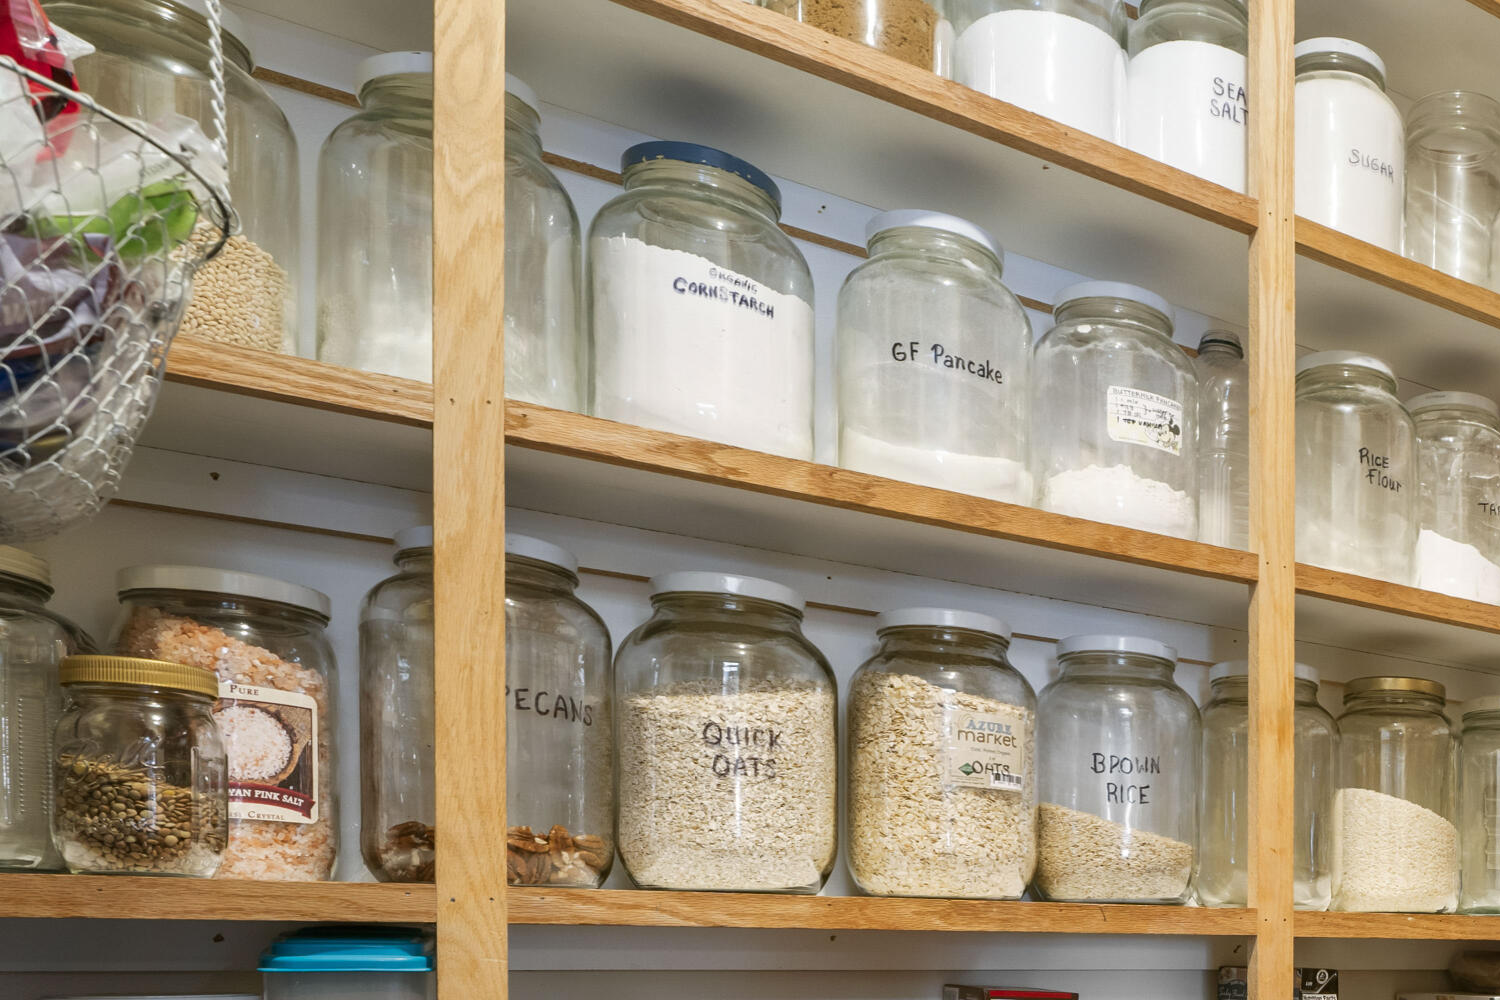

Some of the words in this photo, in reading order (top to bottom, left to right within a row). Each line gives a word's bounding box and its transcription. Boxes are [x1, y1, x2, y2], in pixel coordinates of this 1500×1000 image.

[1213, 77, 1248, 102] SEA
[1348, 149, 1395, 183] SUGAR
[673, 277, 774, 319] CORNSTARCH
[892, 342, 920, 363] GF
[931, 343, 1004, 385] Pancake
[1358, 447, 1389, 469] RICE
[702, 722, 783, 751] QUICK
[958, 730, 1017, 748] market
[966, 720, 1012, 735] AZURE
[711, 753, 777, 780] OATS
[255, 790, 280, 804] PINK
[281, 792, 305, 807] SALT
[1106, 782, 1151, 805] RICE
